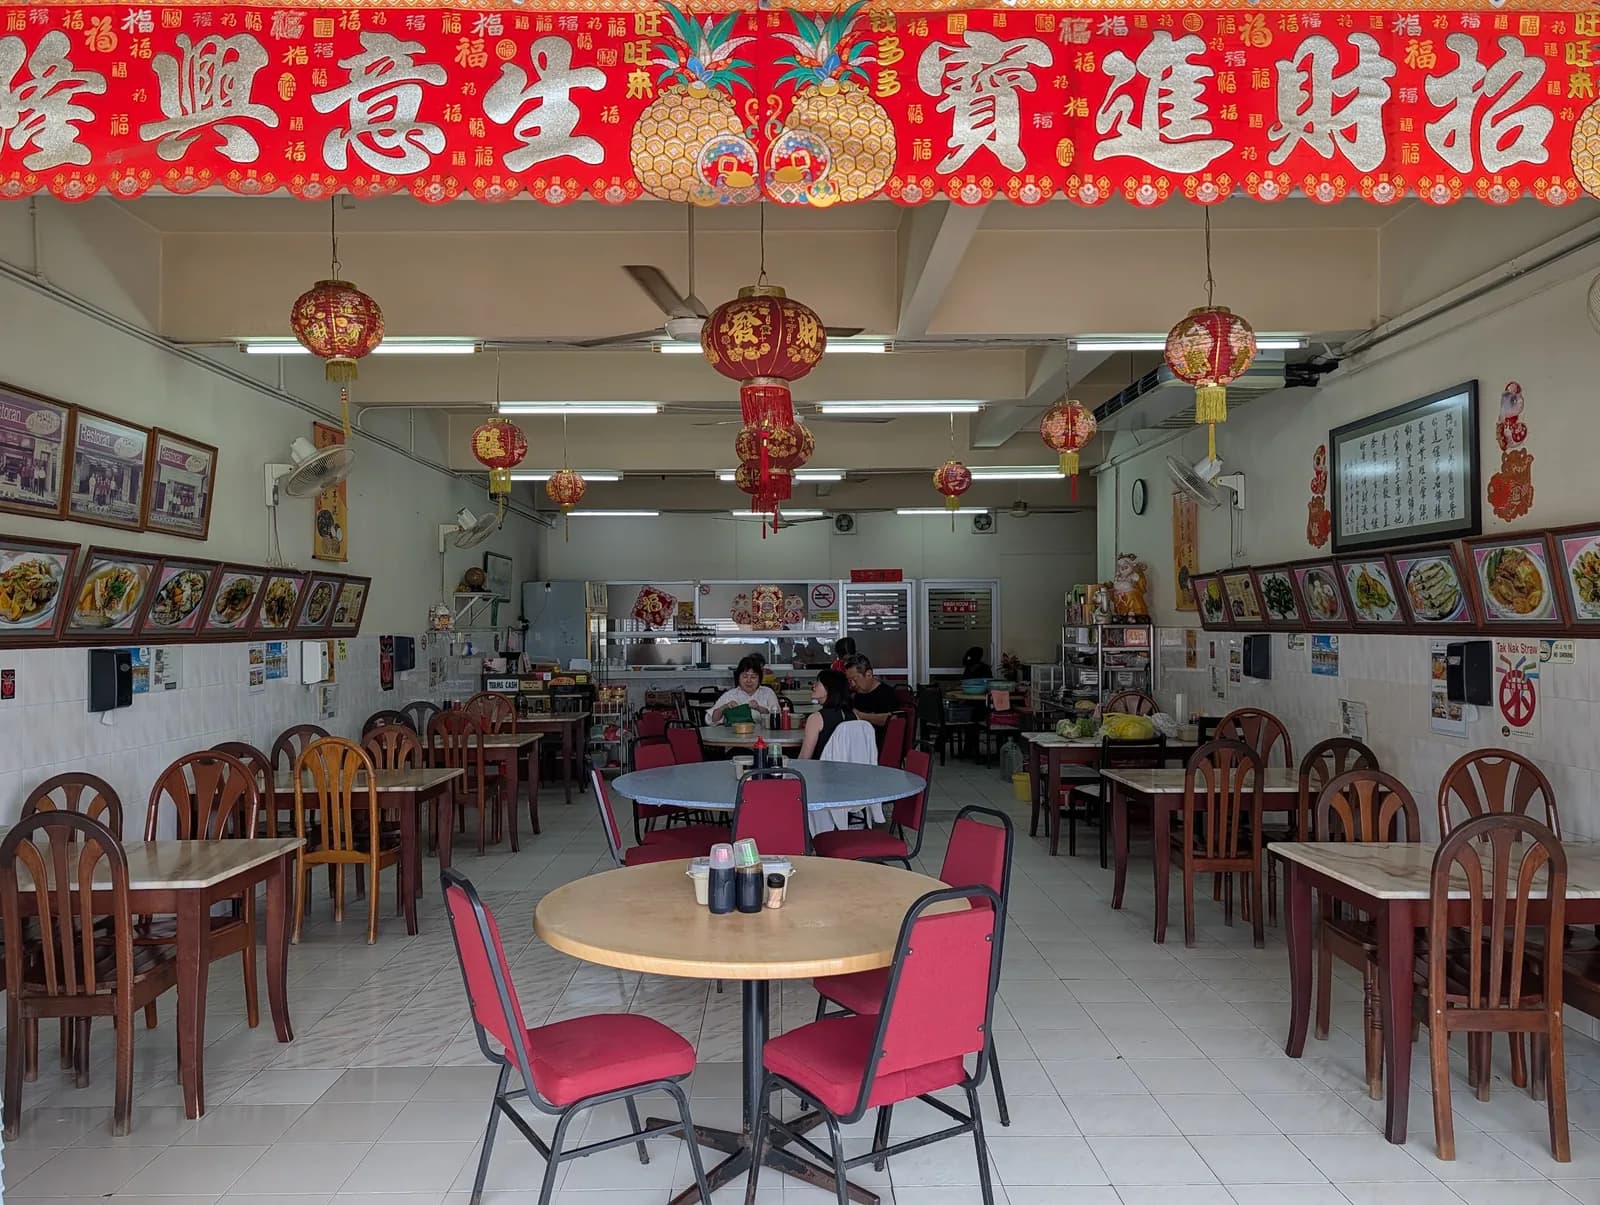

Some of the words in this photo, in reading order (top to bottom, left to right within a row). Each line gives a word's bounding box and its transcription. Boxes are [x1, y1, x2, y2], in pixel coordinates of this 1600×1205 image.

[1496, 642, 1507, 653] Tak
[1508, 642, 1519, 654] Nak
[1520, 643, 1538, 654] Straw
